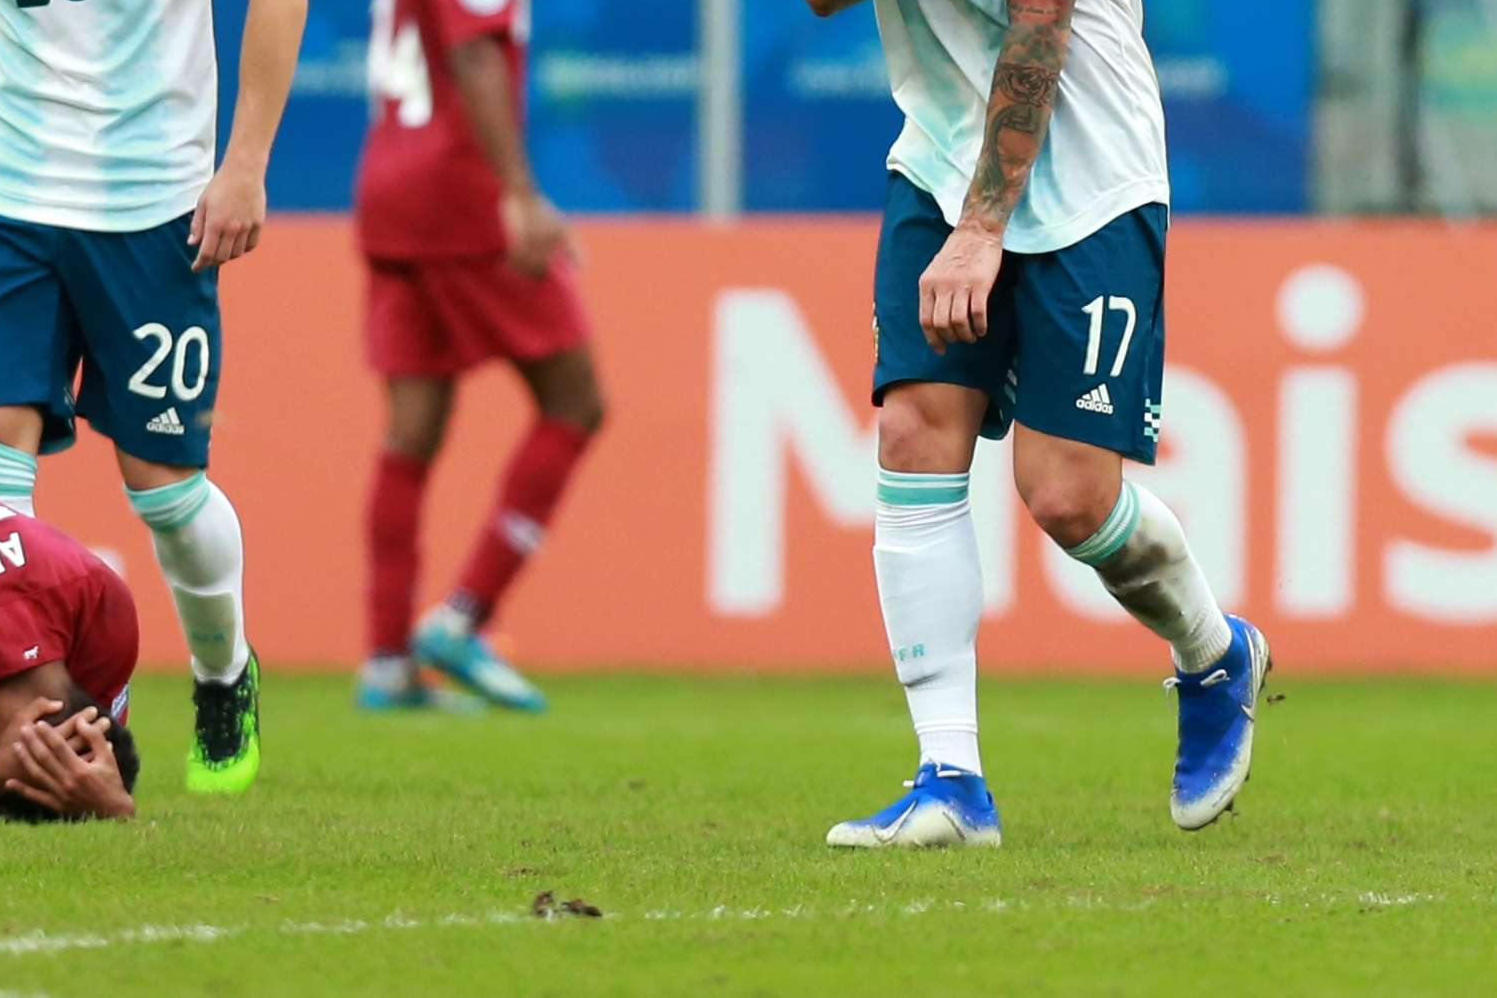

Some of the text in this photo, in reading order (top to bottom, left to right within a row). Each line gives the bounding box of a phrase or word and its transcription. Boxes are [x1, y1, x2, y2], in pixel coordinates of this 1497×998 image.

[1081, 295, 1136, 377] 17
[127, 322, 210, 401] 20
[146, 421, 185, 435] adidas
[1076, 398, 1114, 415] adidas
